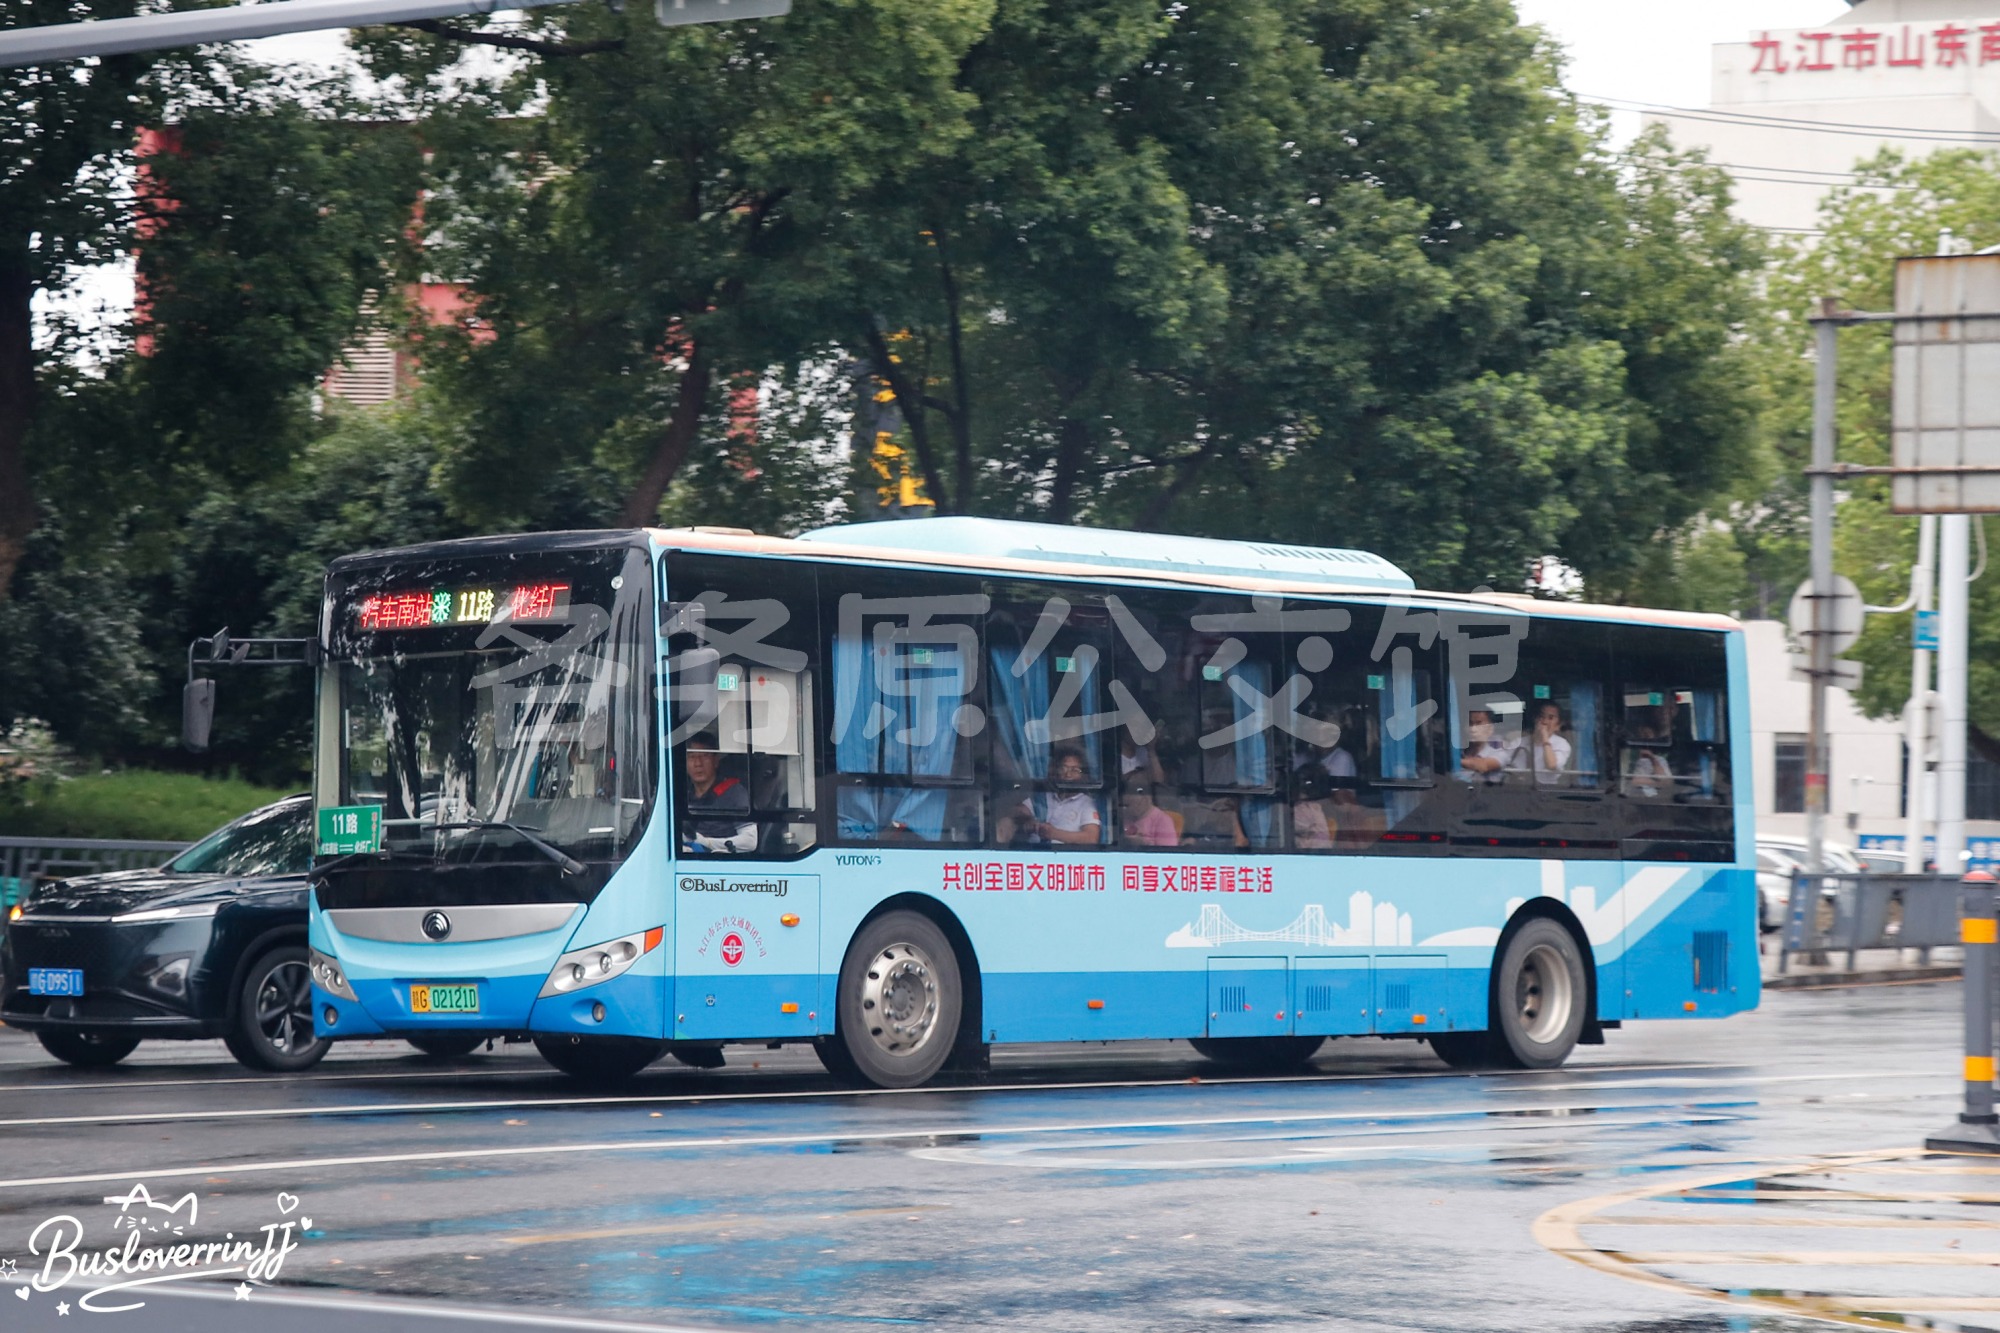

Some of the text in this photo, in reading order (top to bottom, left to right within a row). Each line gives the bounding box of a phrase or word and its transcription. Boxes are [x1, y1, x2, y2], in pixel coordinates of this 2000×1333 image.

[362, 585, 570, 628] 汽车南站 11路 化纤厂
[332, 813, 358, 835] 11路
[835, 855, 882, 866] YUTONG
[943, 862, 1273, 893] 共创全国文明城市 同享文明幸福生活
